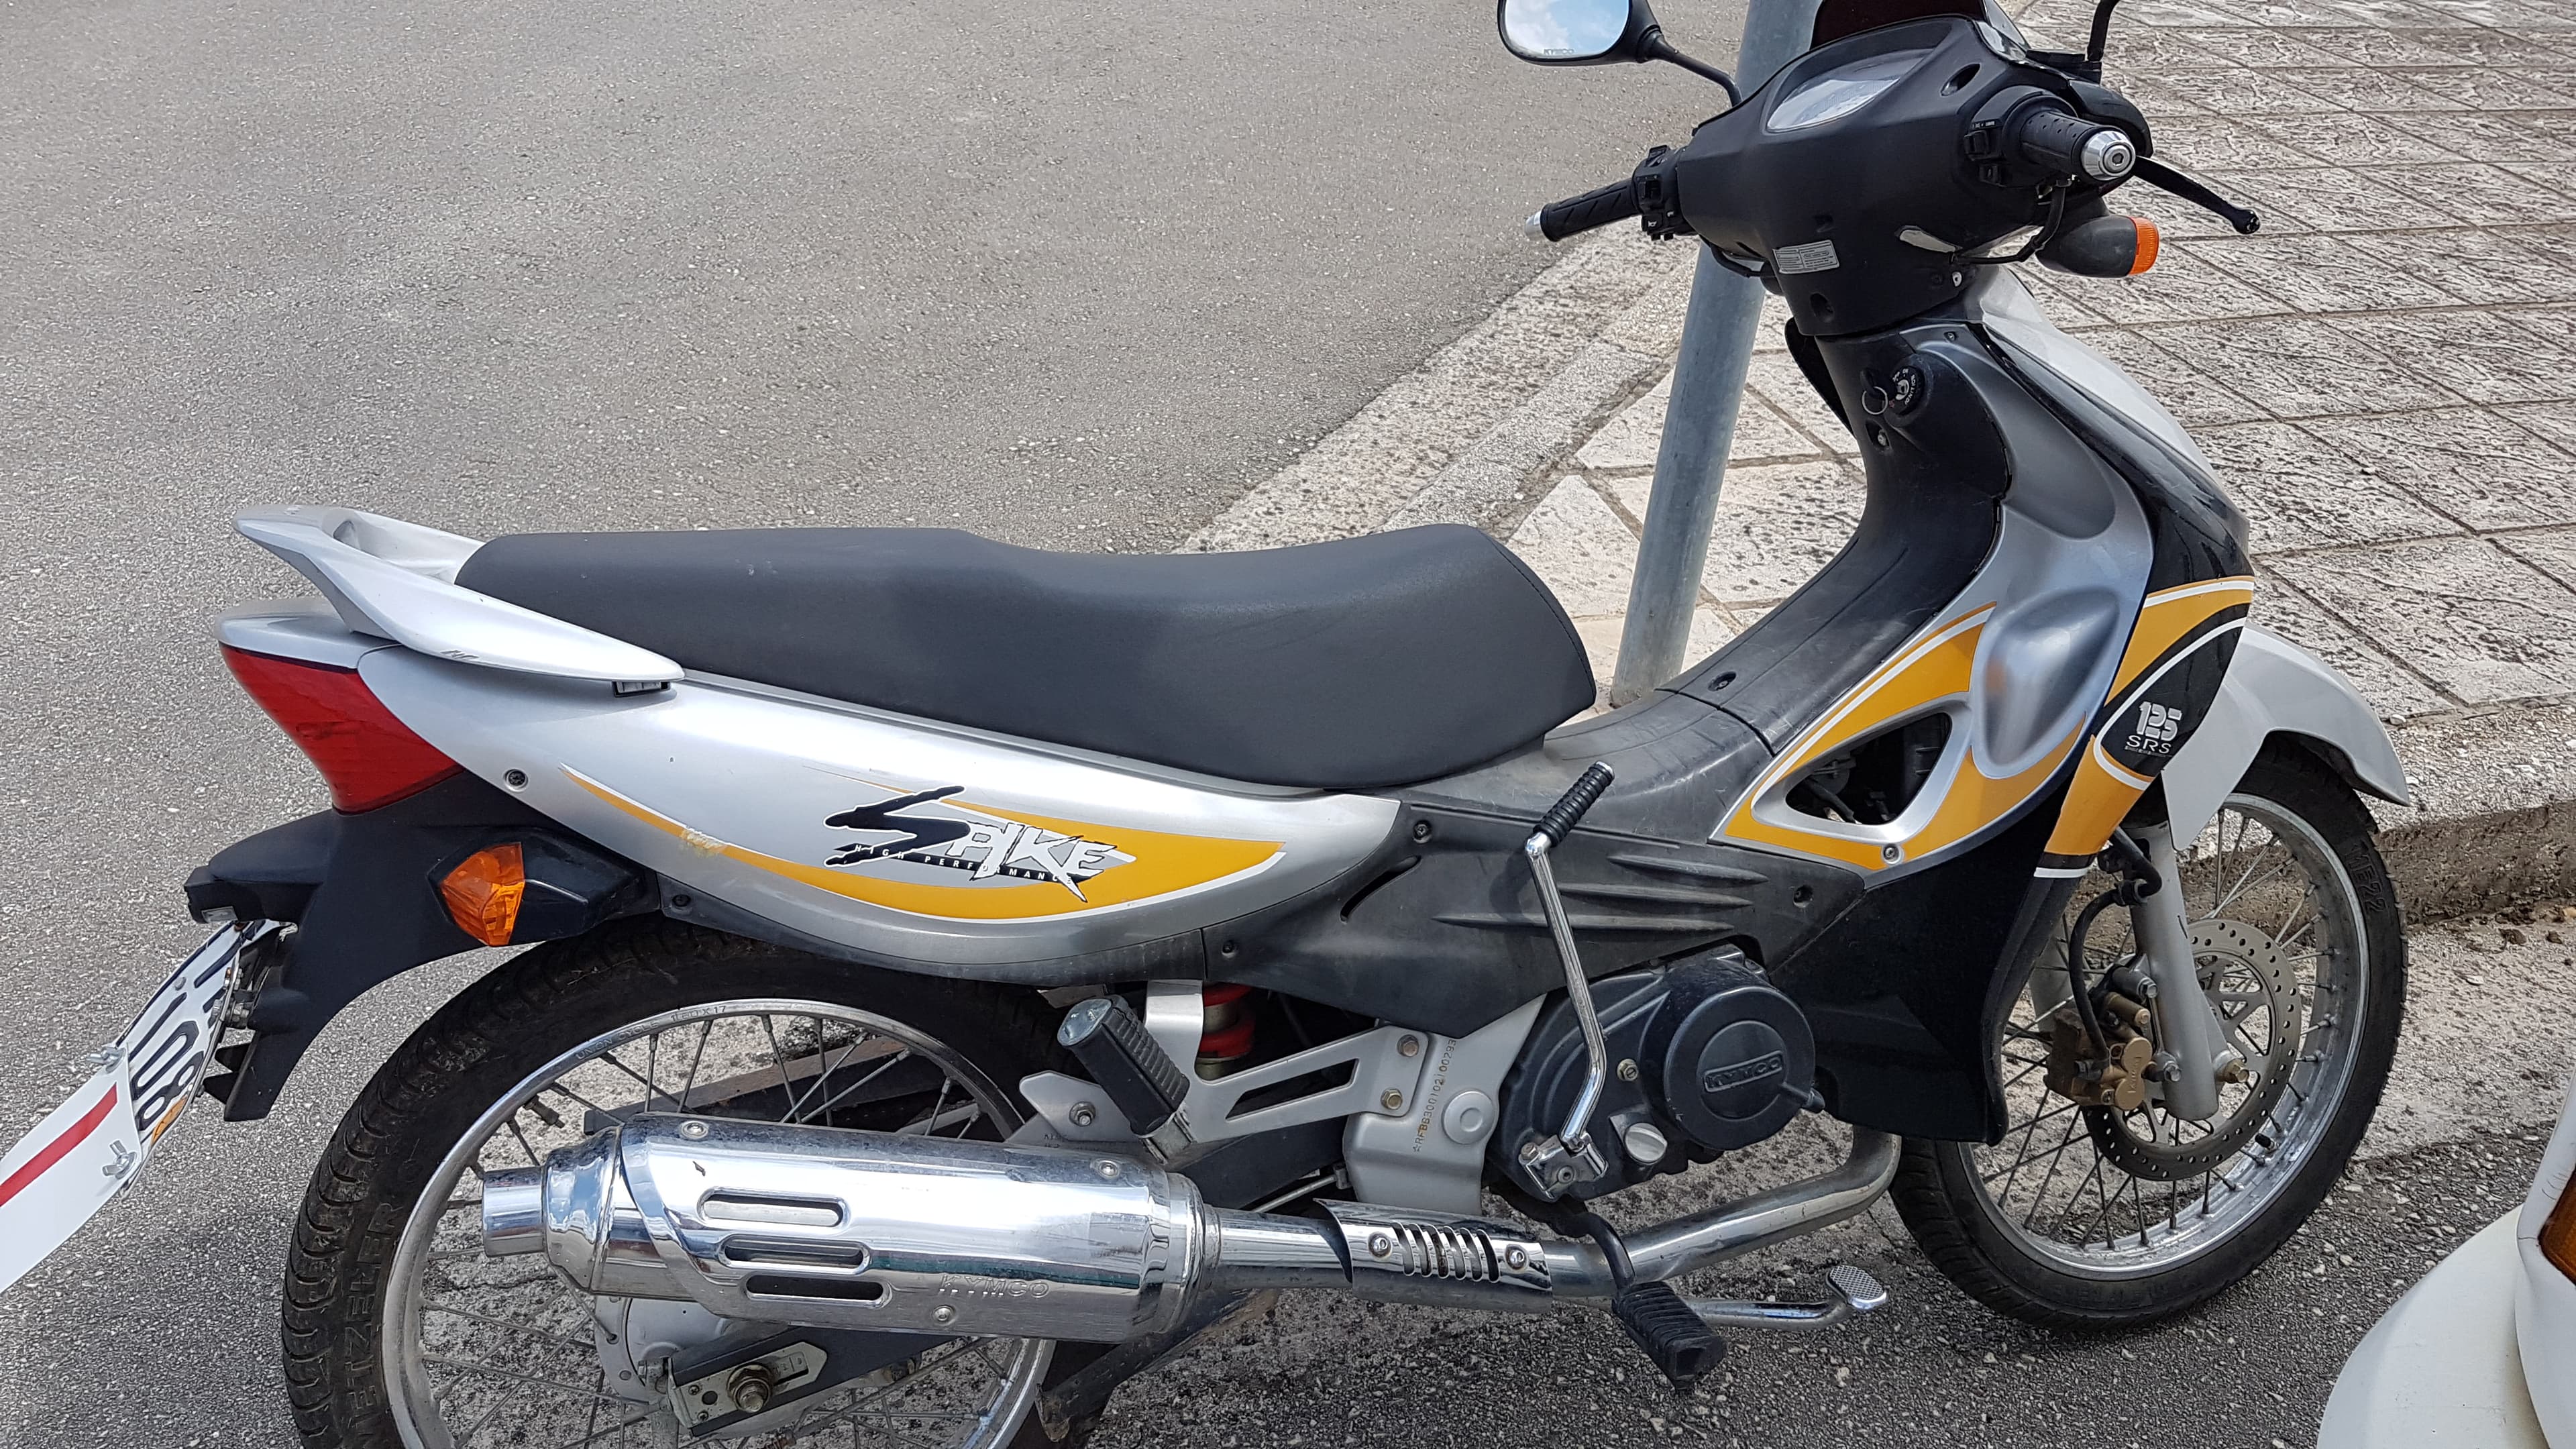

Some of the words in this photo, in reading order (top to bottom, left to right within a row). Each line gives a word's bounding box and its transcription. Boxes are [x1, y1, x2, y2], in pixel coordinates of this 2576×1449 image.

[2136, 701, 2183, 742] 125
[2126, 735, 2171, 754] SRS
[824, 785, 1118, 902] SPIKE
[855, 845, 905, 859] HIGH
[924, 855, 1073, 885] PERFORMANCE
[617, 1021, 660, 1040] CYCLE
[714, 1006, 726, 1014] 17
[939, 1274, 1049, 1299] KYMCO
